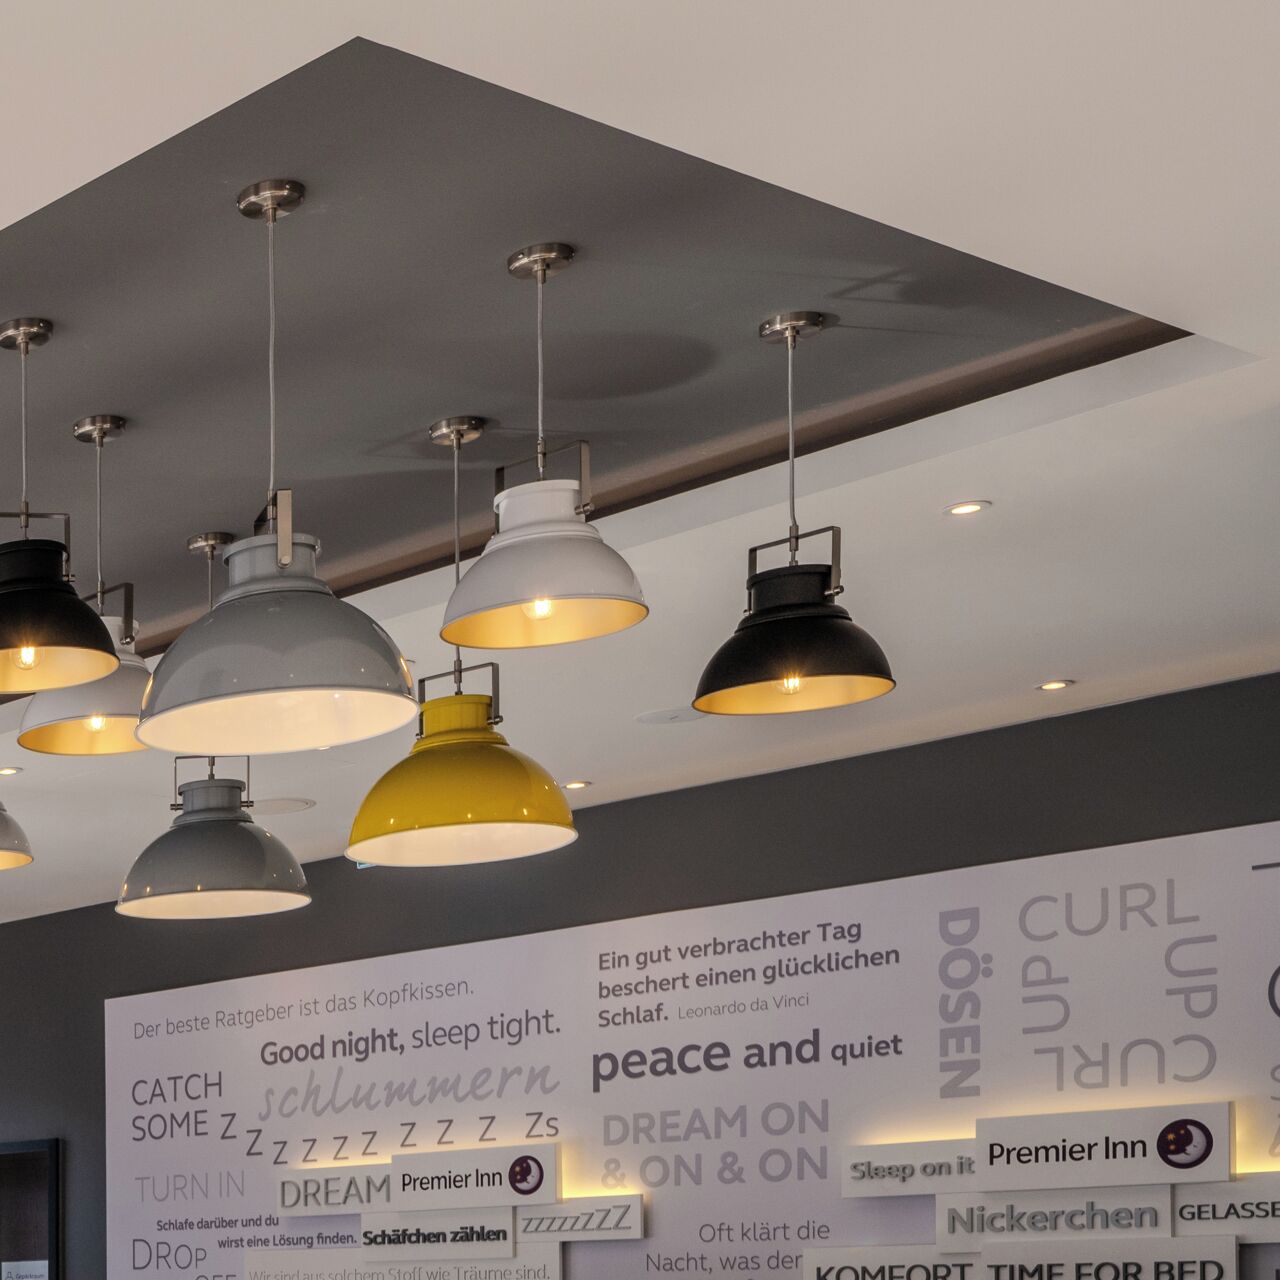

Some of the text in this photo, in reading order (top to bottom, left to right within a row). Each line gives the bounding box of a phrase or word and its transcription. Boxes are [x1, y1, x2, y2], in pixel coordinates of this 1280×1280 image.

[1018, 878, 1200, 942] CURL
[598, 922, 862, 971] Ein gut verbrachter Tag
[598, 948, 900, 999] beschert einen glücklichen
[1164, 934, 1218, 1019] UP
[134, 980, 475, 1039] Der beste Ratgeber ist das Kopfkissen.
[598, 993, 809, 1028] Schlaf. Leonardo da Vinci
[938, 906, 994, 1099] DÖSEN
[1021, 955, 1071, 1035] UP
[260, 1009, 561, 1066] Good night, sleep tight.
[592, 1028, 903, 1093] peace and quiet
[1034, 1034, 1218, 1092] CURL
[131, 1071, 223, 1106] CATCH
[258, 1064, 561, 1122] schlummern
[132, 1110, 209, 1142] SOME
[525, 1112, 559, 1139] Zs
[603, 1099, 829, 1146] DREAM ON
[601, 1146, 828, 1189] & ON & ON
[850, 1155, 976, 1182] Sleep on it
[988, 1136, 1148, 1166] Premier Inn
[135, 1170, 245, 1202] TURN IN
[280, 1174, 391, 1209] DREAM
[401, 1168, 503, 1192] Premier Inn
[156, 1214, 280, 1231] Schlafe darüber und du
[699, 1220, 830, 1243] Oft klärt die
[947, 1201, 1159, 1235] Nickerchen
[217, 1232, 357, 1249] wirst eine Lösung finden.
[362, 1226, 507, 1246] Schäfchen zählen
[426, 1265, 450, 1280] wie
[454, 1264, 510, 1280] Träume
[515, 1264, 550, 1280] sind.
[646, 1250, 803, 1273] Nacht, was der
